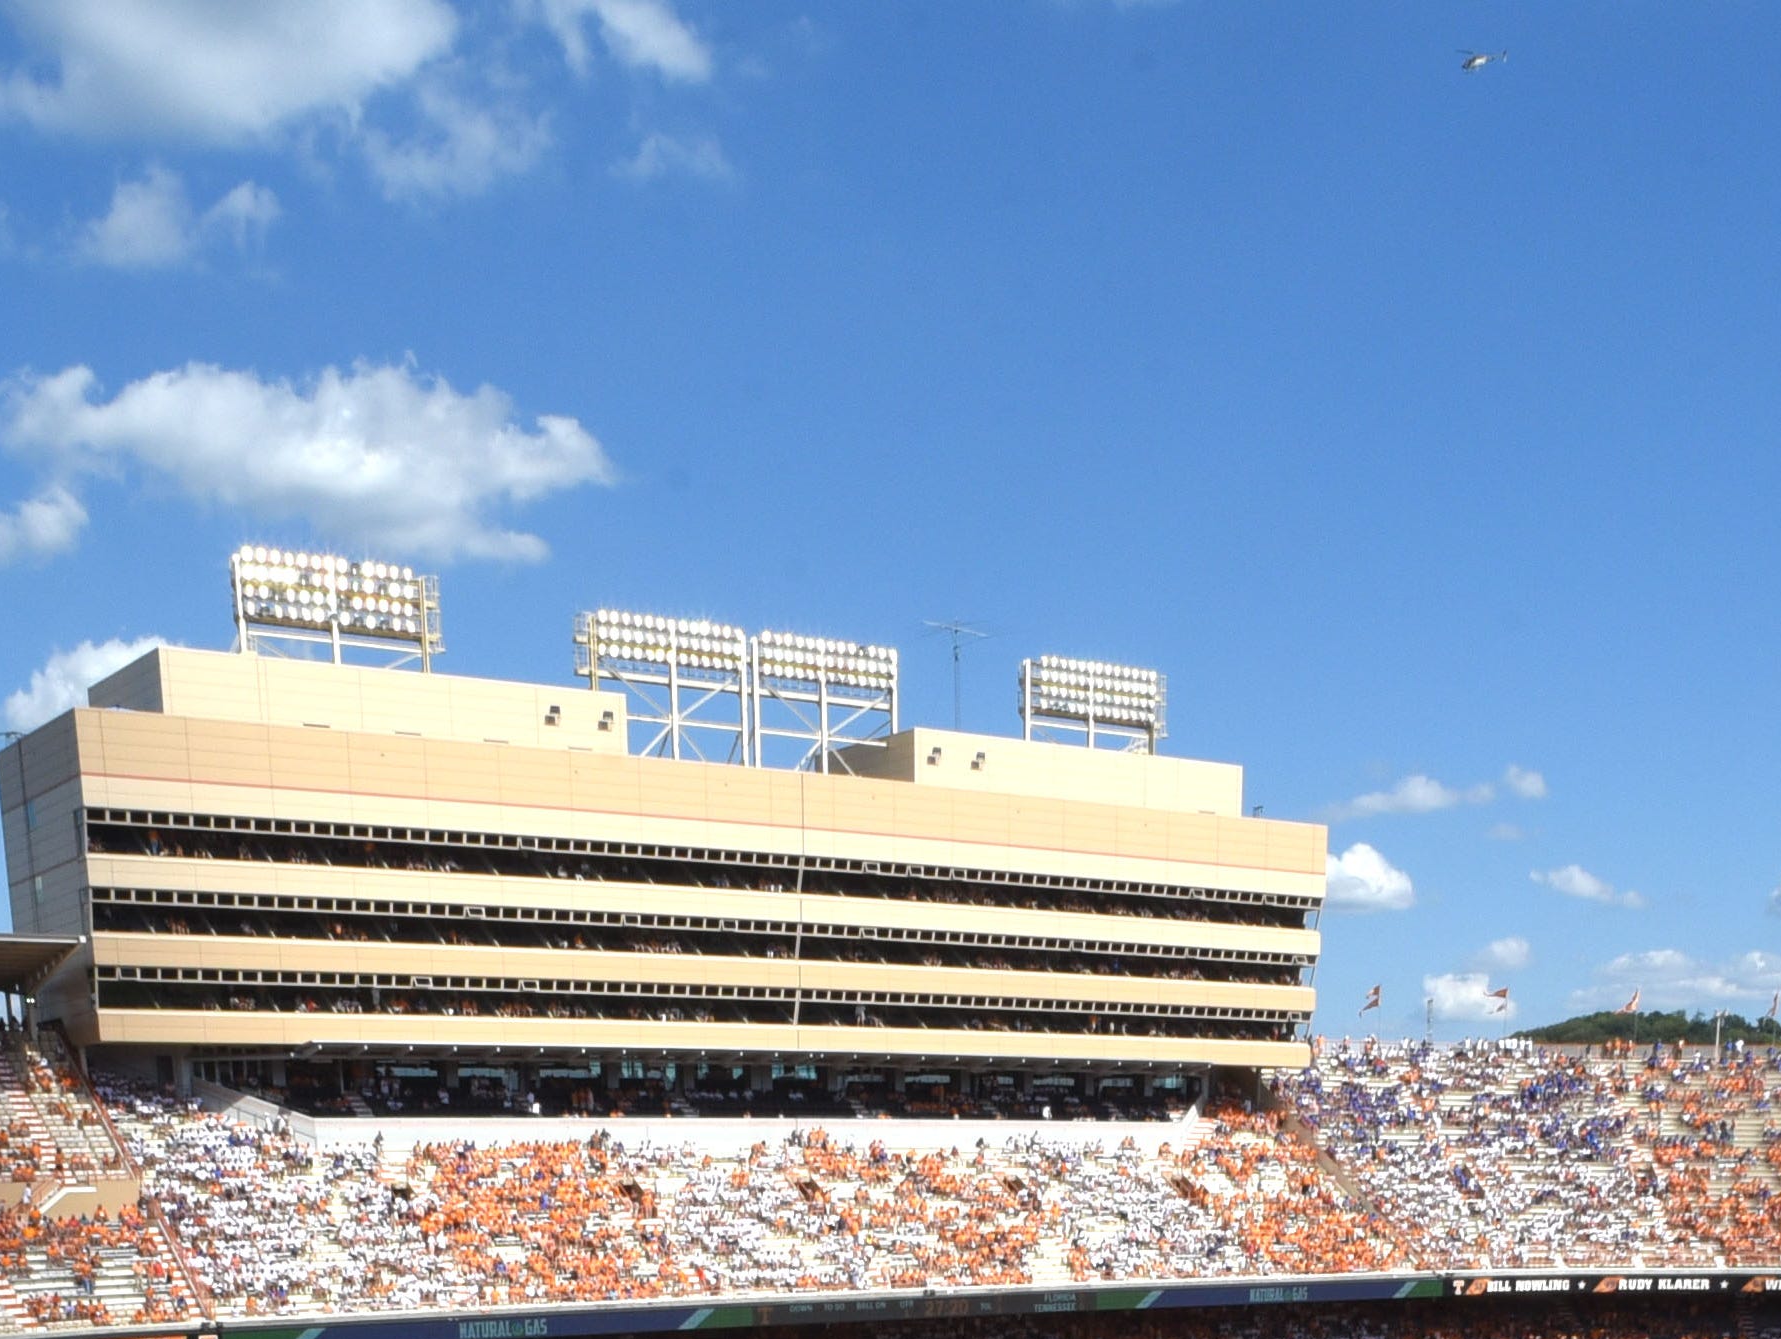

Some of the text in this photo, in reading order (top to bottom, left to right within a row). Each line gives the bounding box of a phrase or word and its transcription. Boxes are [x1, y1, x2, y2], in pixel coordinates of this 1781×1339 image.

[1515, 1279, 1570, 1292] NOWLING
[1619, 1278, 1653, 1291] RUDY
[1658, 1278, 1710, 1291] KLARER
[1033, 1303, 1076, 1313] TENNESSEE
[459, 1317, 548, 1339] NATURAL GAS
